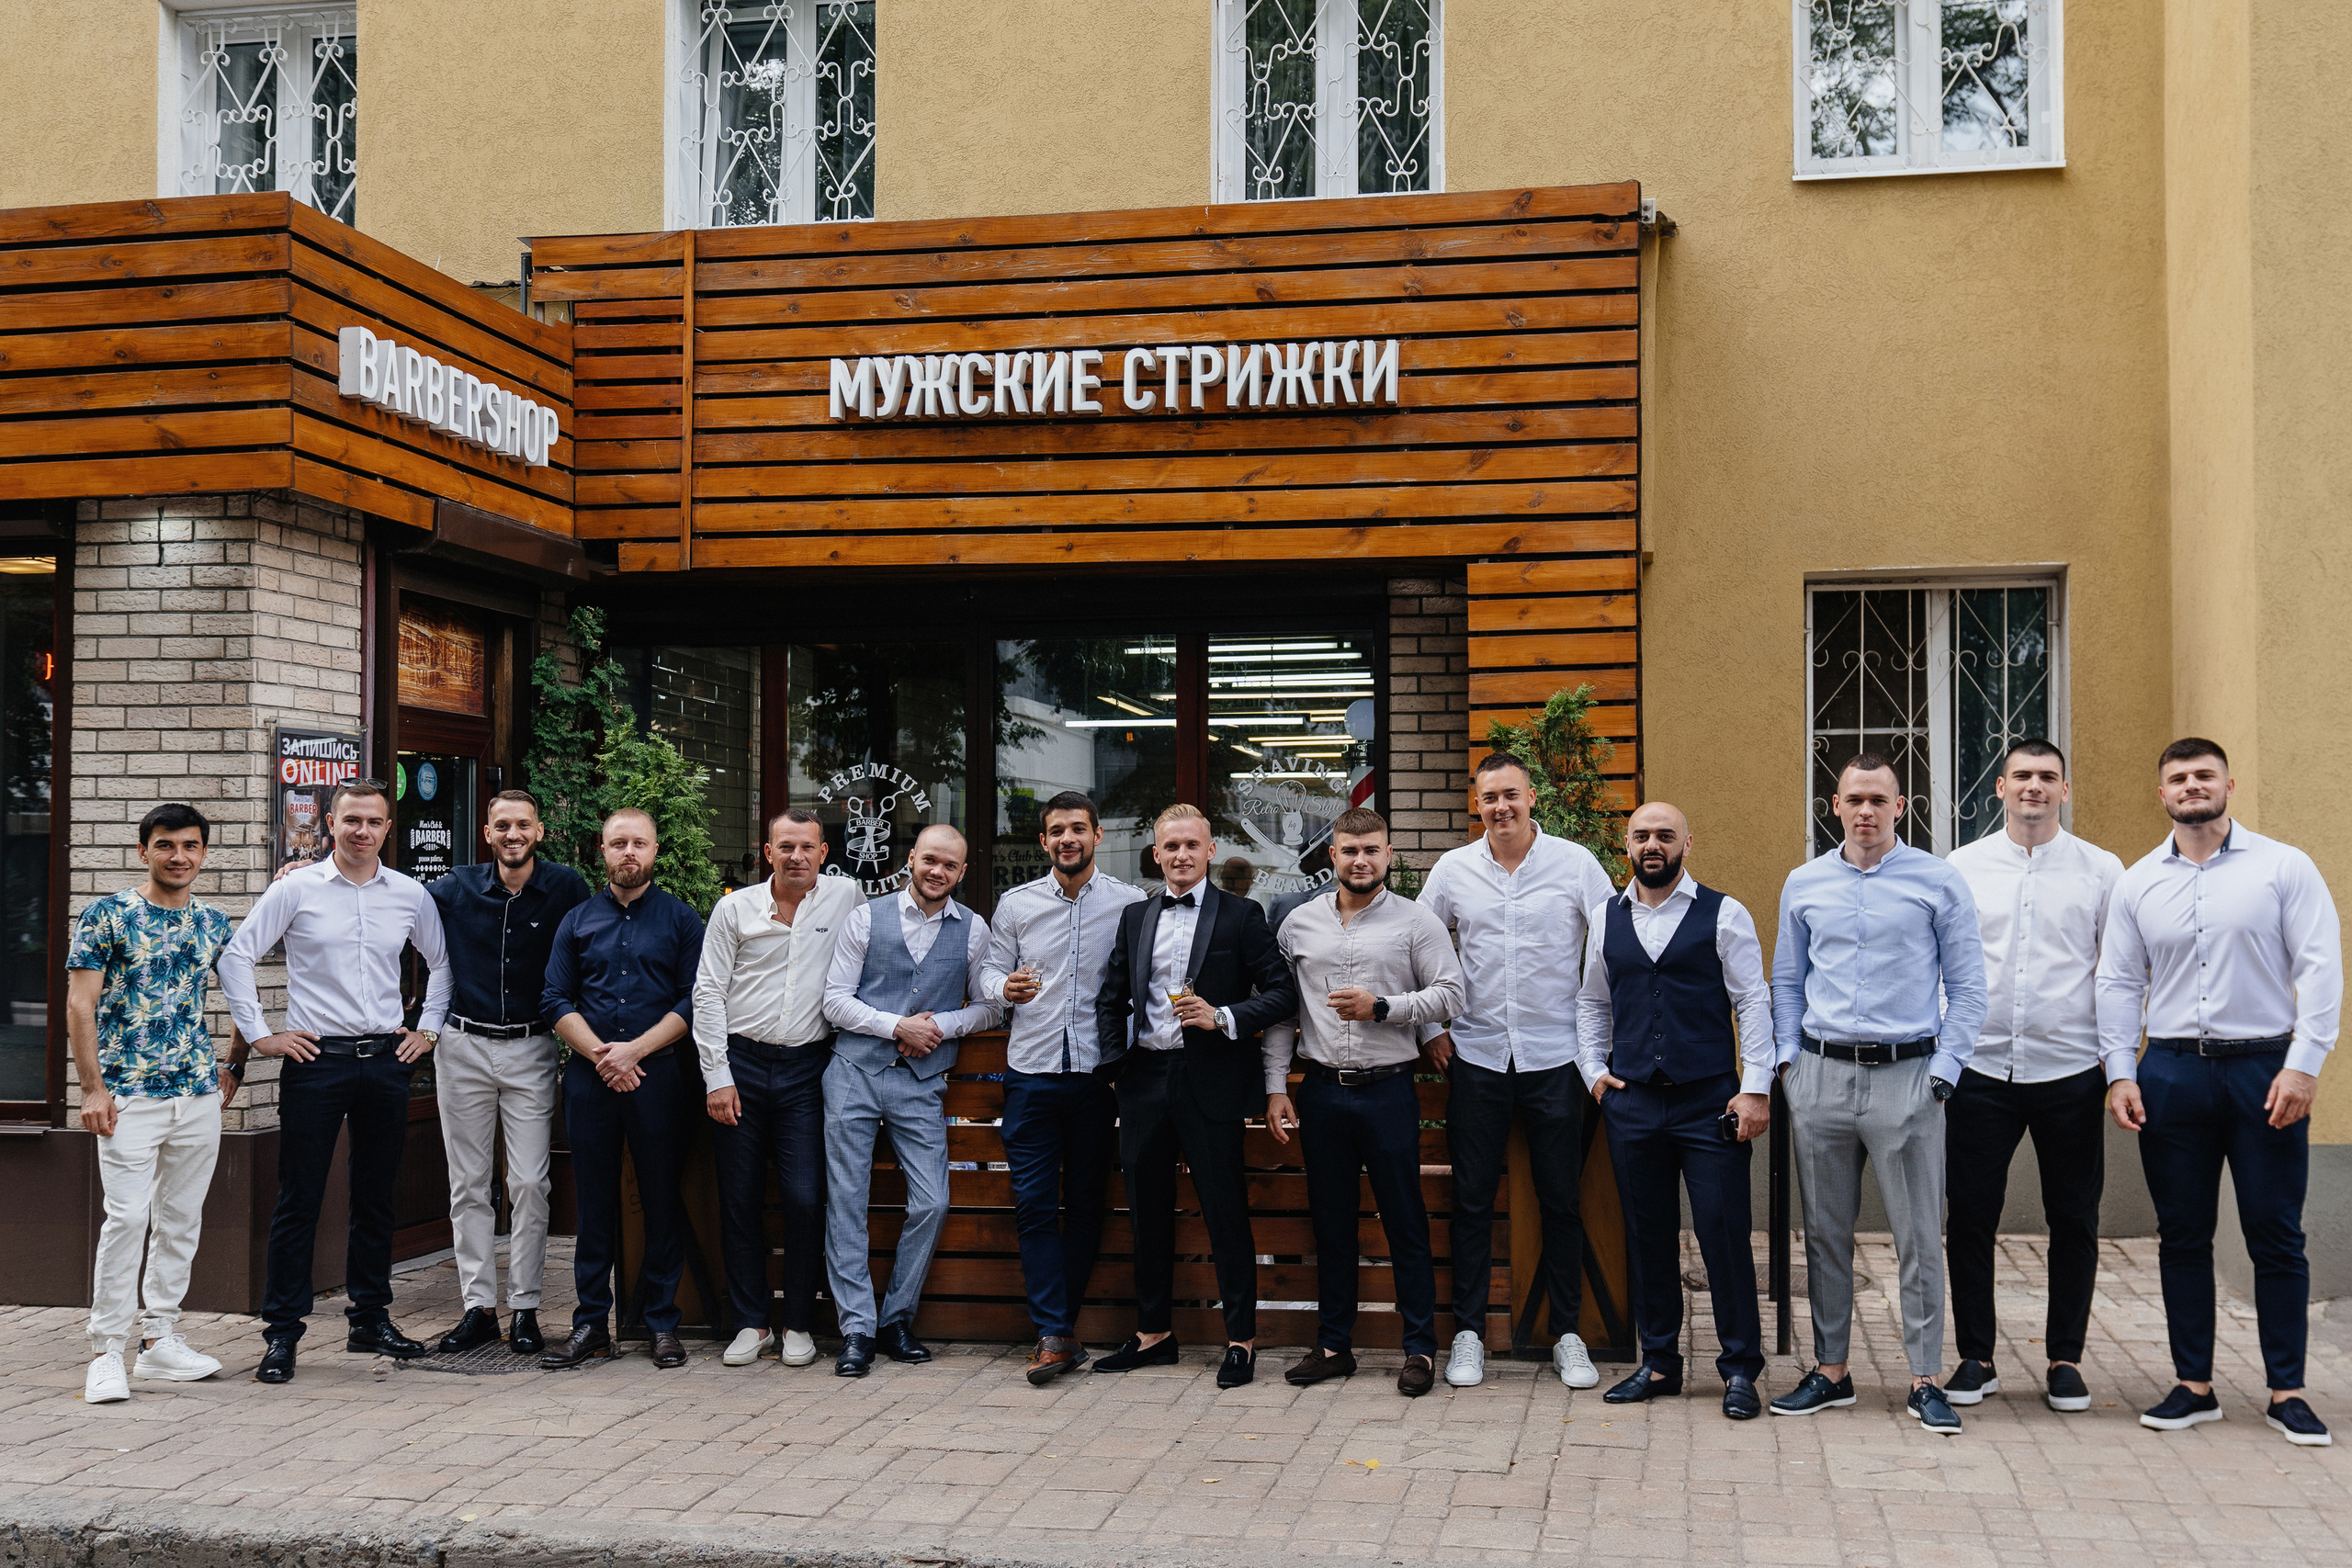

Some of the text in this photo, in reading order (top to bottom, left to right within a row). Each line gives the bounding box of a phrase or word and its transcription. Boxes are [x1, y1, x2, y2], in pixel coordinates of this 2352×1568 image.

[830, 339, 1400, 422] МУЖСКИЕ СТРИЖКИ
[338, 326, 559, 467] BARBERSHOP
[281, 737, 357, 761] ЗАПИШИСЬ
[281, 758, 356, 786] ONLINE
[1238, 757, 1346, 795] SHAVING
[818, 762, 932, 814] PREMIUM
[289, 803, 317, 817] BARBER
[1242, 796, 1342, 817] Retro Style
[855, 818, 884, 828] BARBER
[415, 829, 446, 846] BARBER
[858, 852, 877, 860] SHOP
[1008, 849, 1032, 863] Club
[826, 863, 912, 895] QLITY
[993, 865, 1053, 886] RBE
[1253, 868, 1332, 892] BEARD
